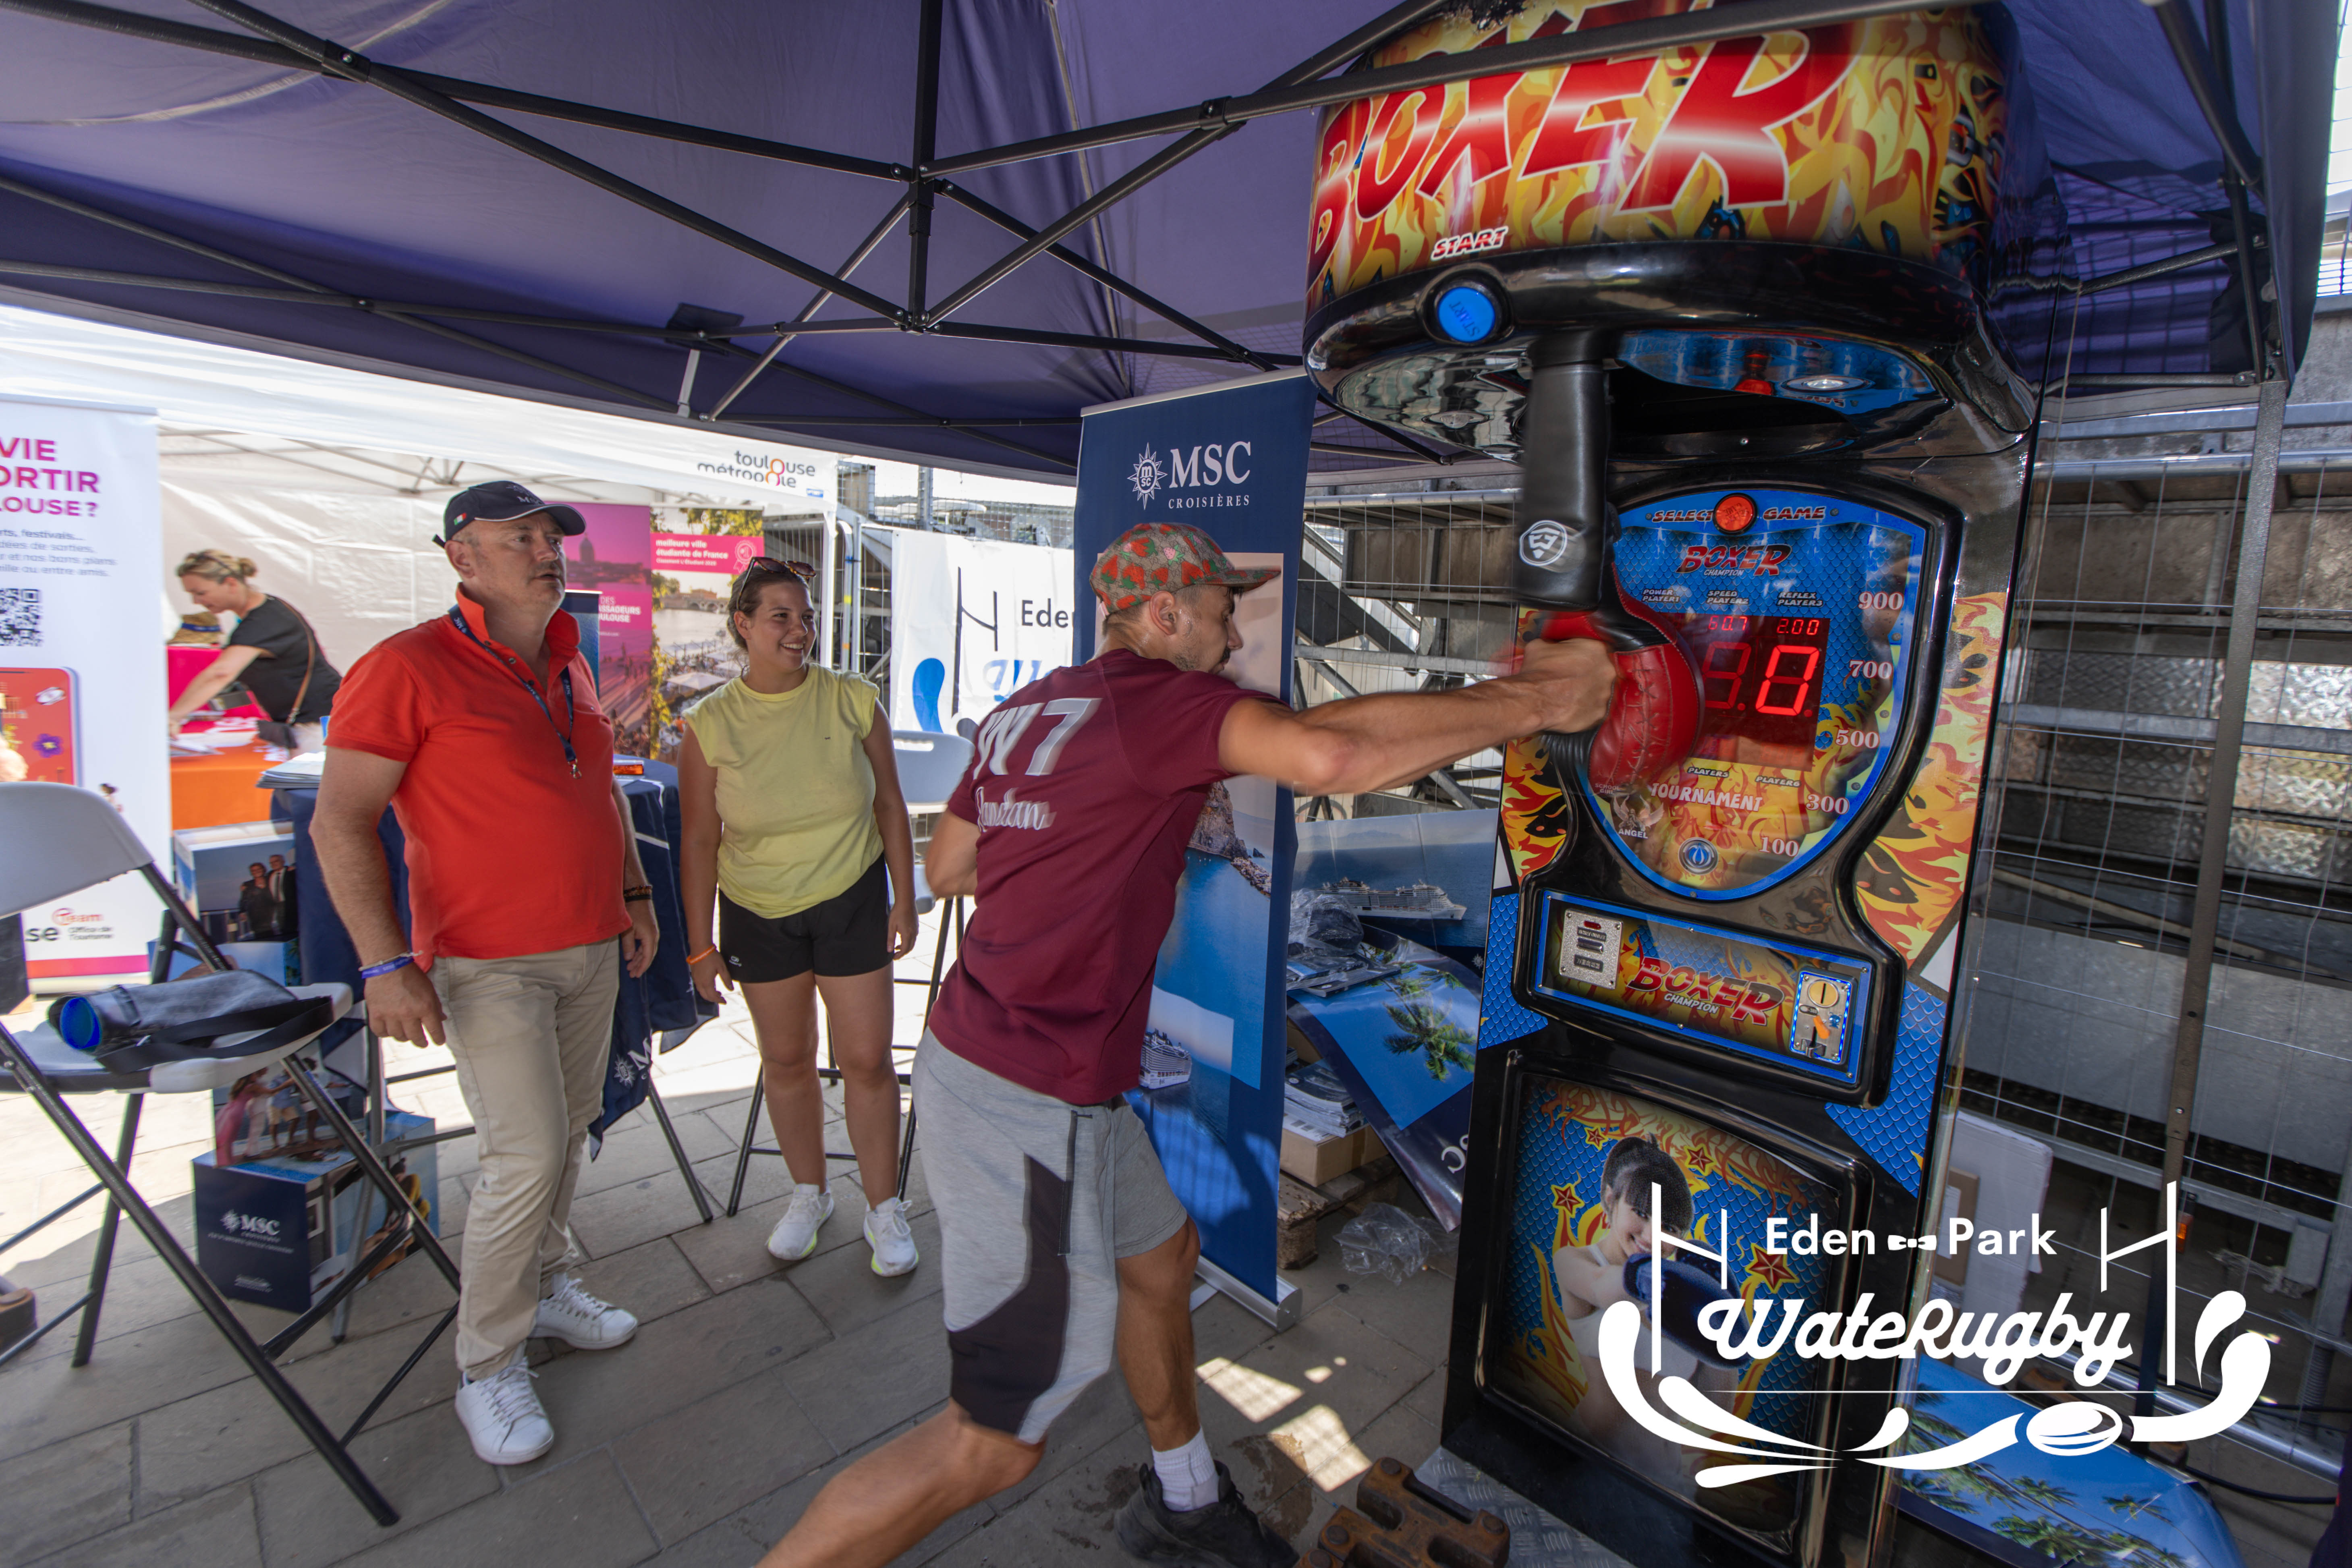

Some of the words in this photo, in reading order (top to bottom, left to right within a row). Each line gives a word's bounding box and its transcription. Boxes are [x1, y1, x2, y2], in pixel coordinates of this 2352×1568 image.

[1305, 0, 1871, 287] BOXER
[1431, 226, 1508, 261] START
[1449, 301, 1480, 337] START
[734, 450, 815, 477] toulouse
[1169, 442, 1251, 488] MSC
[0, 496, 97, 517] OUSE?
[1168, 494, 1249, 509] CROISIÈRES
[1652, 510, 1714, 522] SELECT
[1763, 506, 1826, 521] GAME
[656, 539, 689, 547] meilleure
[691, 540, 707, 548] ville
[656, 548, 691, 557] étudiante
[703, 550, 728, 559] France
[1676, 544, 1792, 576] BOXER
[1858, 591, 1904, 610] 900
[1022, 598, 1074, 628] Ede
[1776, 618, 1820, 635] 2.00
[1850, 660, 1892, 679] 700
[1836, 729, 1879, 749] 500
[1688, 767, 1729, 778] PLAYER5
[1755, 776, 1801, 787] PLAYER6
[1651, 782, 1763, 811] TOURNAMENT
[1806, 794, 1849, 815] 300
[1618, 828, 1648, 839] ANGEL
[1759, 837, 1800, 857] 100
[1626, 956, 1785, 1026] BOXER
[1664, 993, 1719, 1014] CHAMPION
[241, 1214, 281, 1236] MSC
